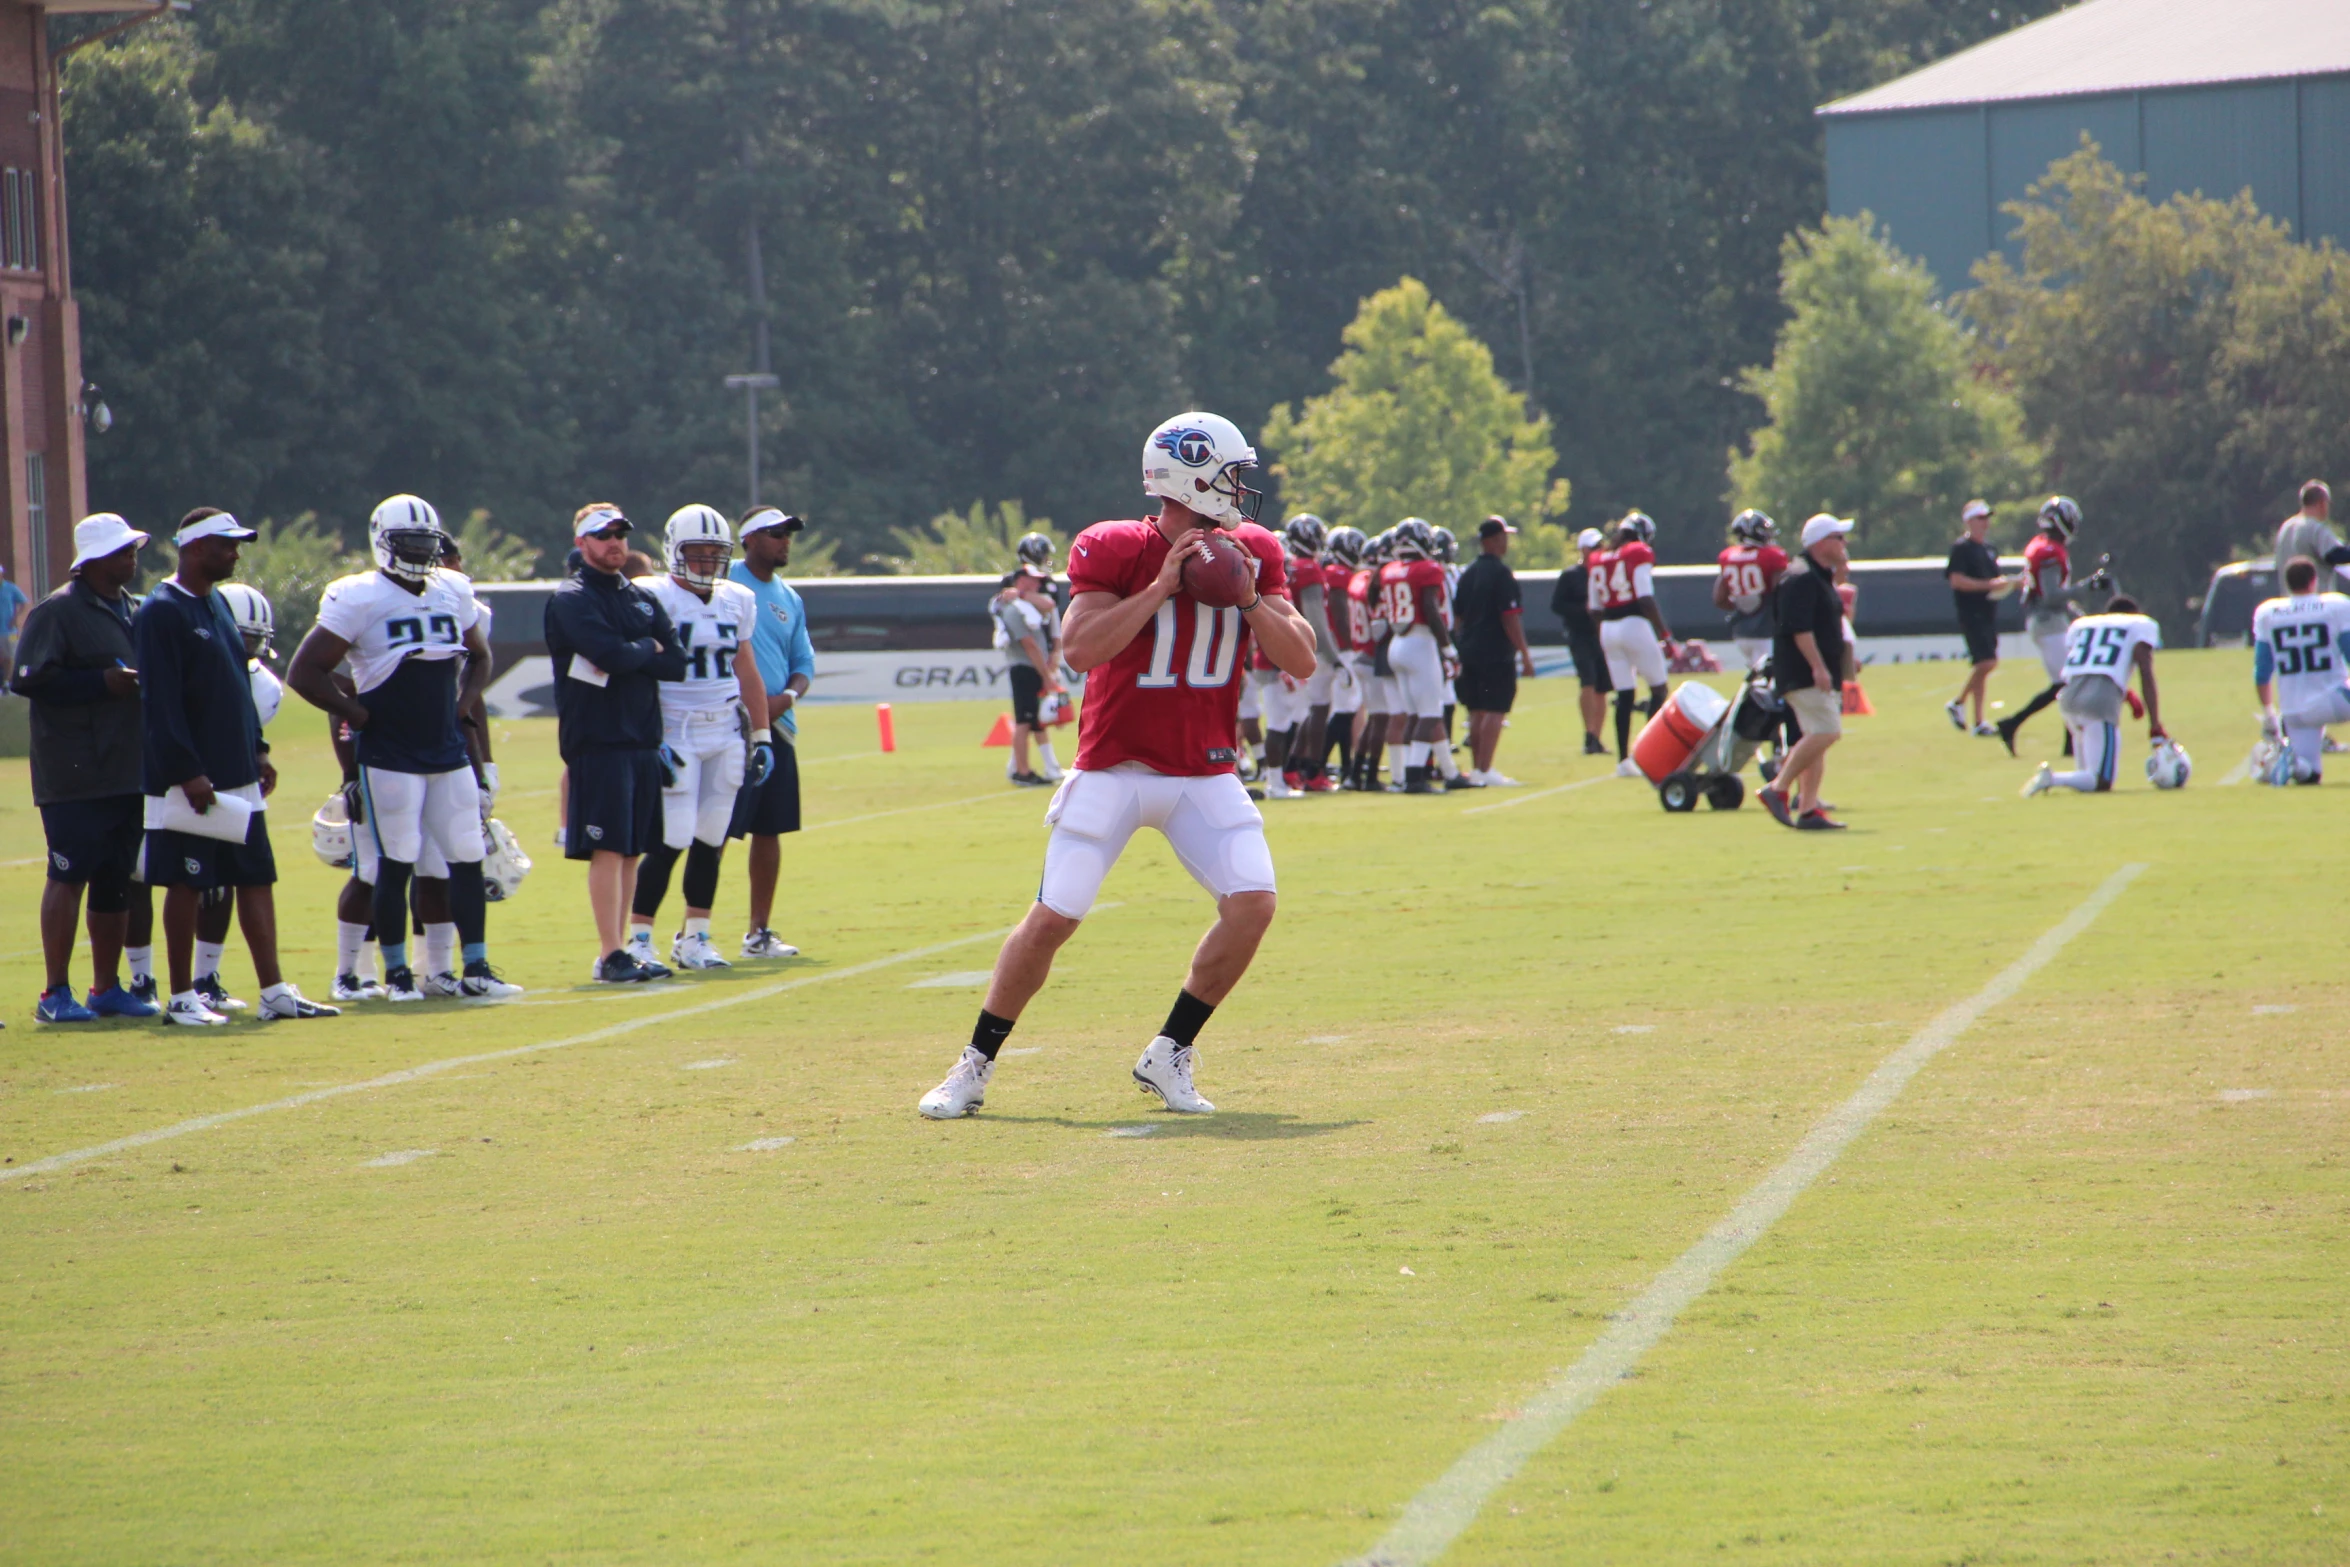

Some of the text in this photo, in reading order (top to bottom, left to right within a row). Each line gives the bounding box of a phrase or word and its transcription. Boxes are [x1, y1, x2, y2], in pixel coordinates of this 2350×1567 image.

[1588, 560, 1633, 611] 84
[1723, 564, 1766, 602] 30
[679, 621, 739, 679] 42
[1136, 597, 1242, 688] 10
[2066, 627, 2128, 667] 35
[2272, 623, 2333, 676] 52
[895, 665, 1009, 688] GRAY
